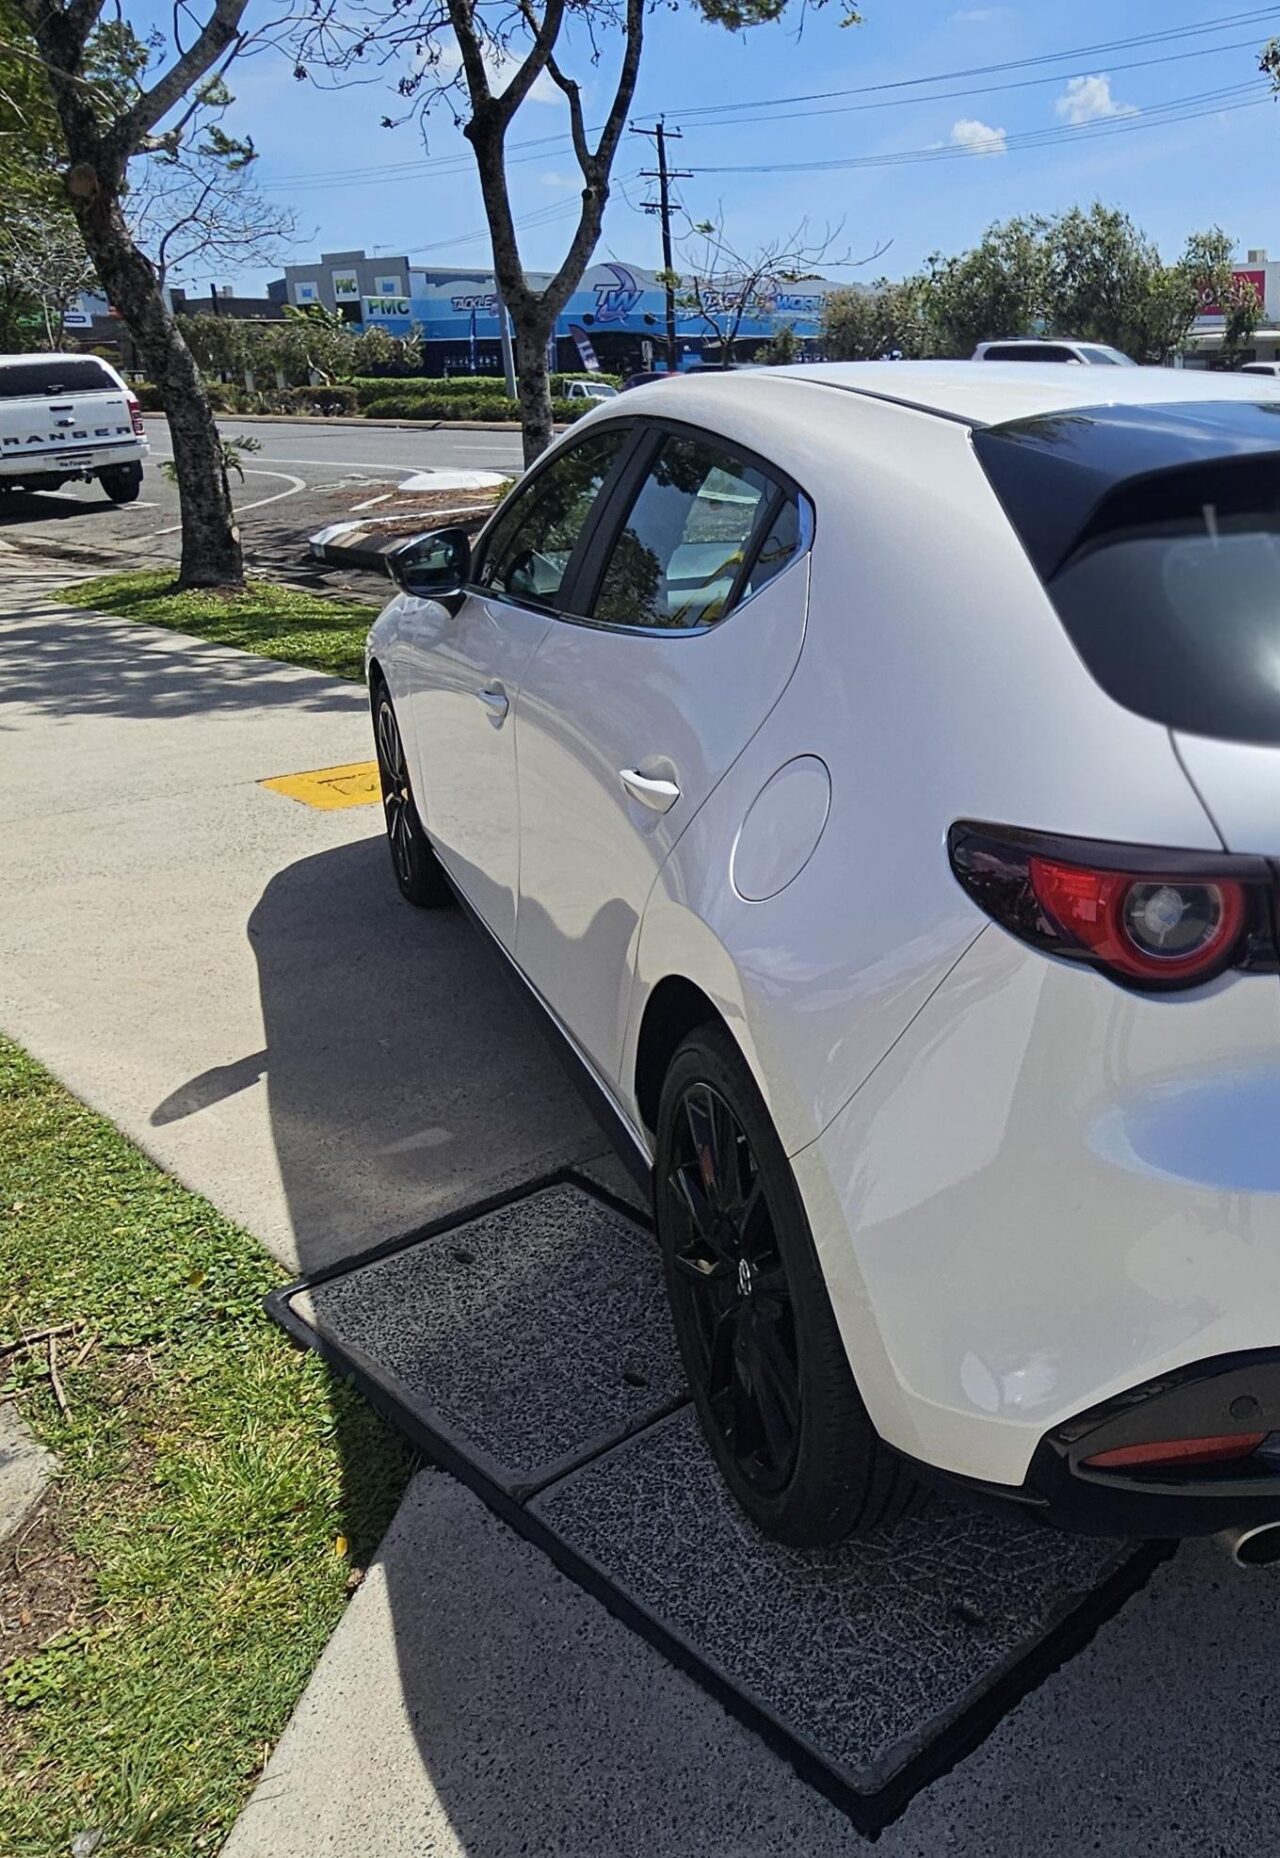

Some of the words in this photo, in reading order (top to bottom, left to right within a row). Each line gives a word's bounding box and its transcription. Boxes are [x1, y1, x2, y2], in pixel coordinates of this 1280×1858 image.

[335, 278, 357, 295] PMC
[451, 295, 494, 312] TACKLE
[593, 283, 645, 313] TW
[368, 299, 410, 315] PMC
[2, 426, 132, 446] RANGER
